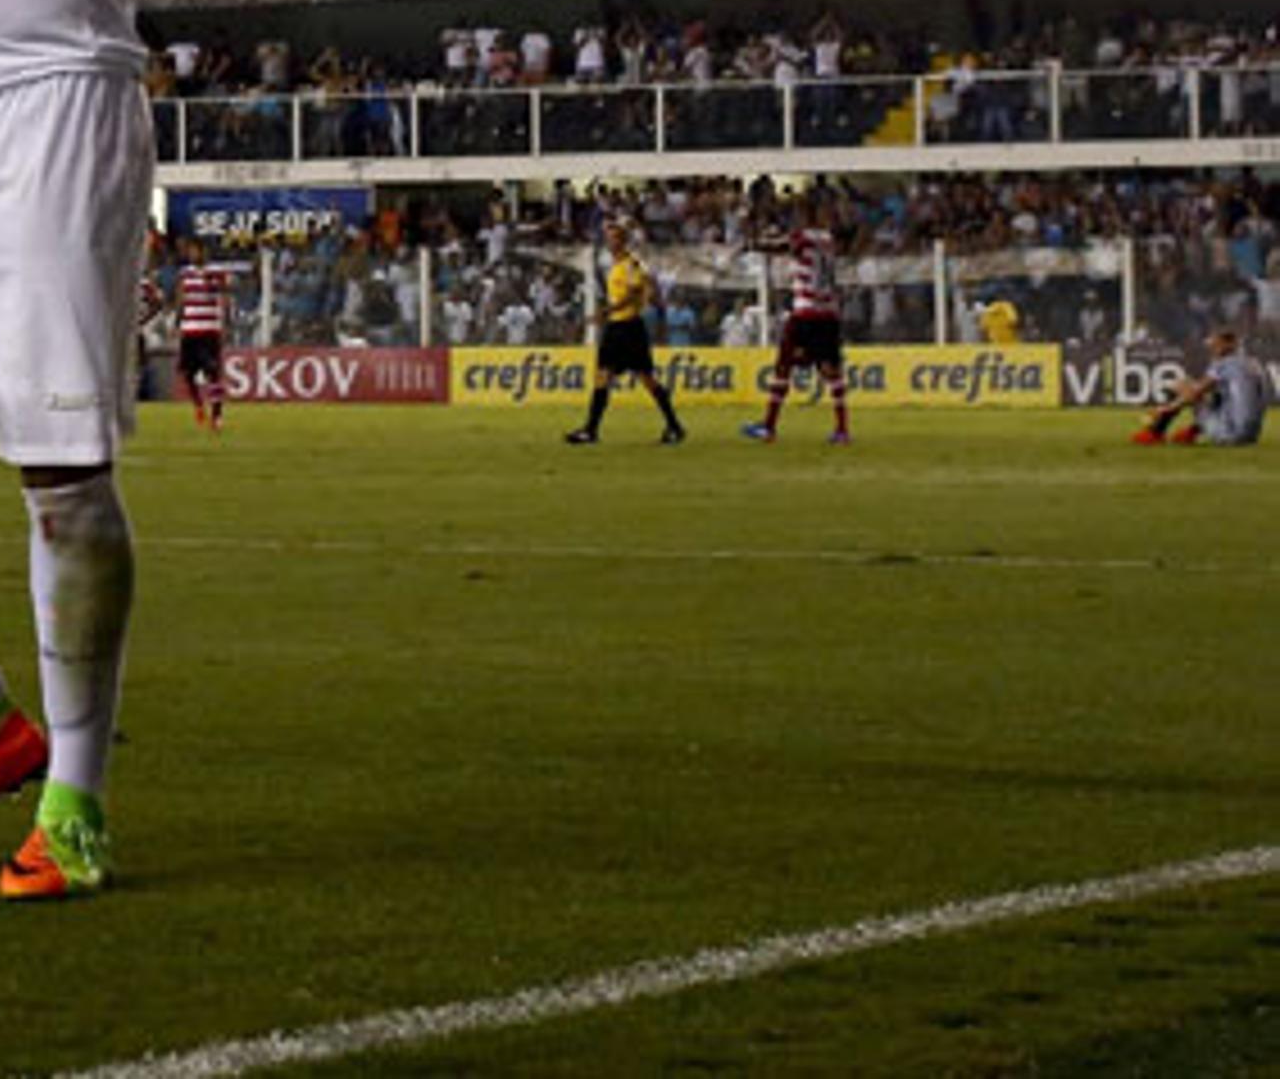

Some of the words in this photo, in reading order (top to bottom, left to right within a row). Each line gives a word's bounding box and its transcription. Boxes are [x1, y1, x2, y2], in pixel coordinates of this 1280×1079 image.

[223, 355, 359, 399] SKOV
[464, 352, 585, 400] crefisa
[910, 352, 1044, 402] crefisa
